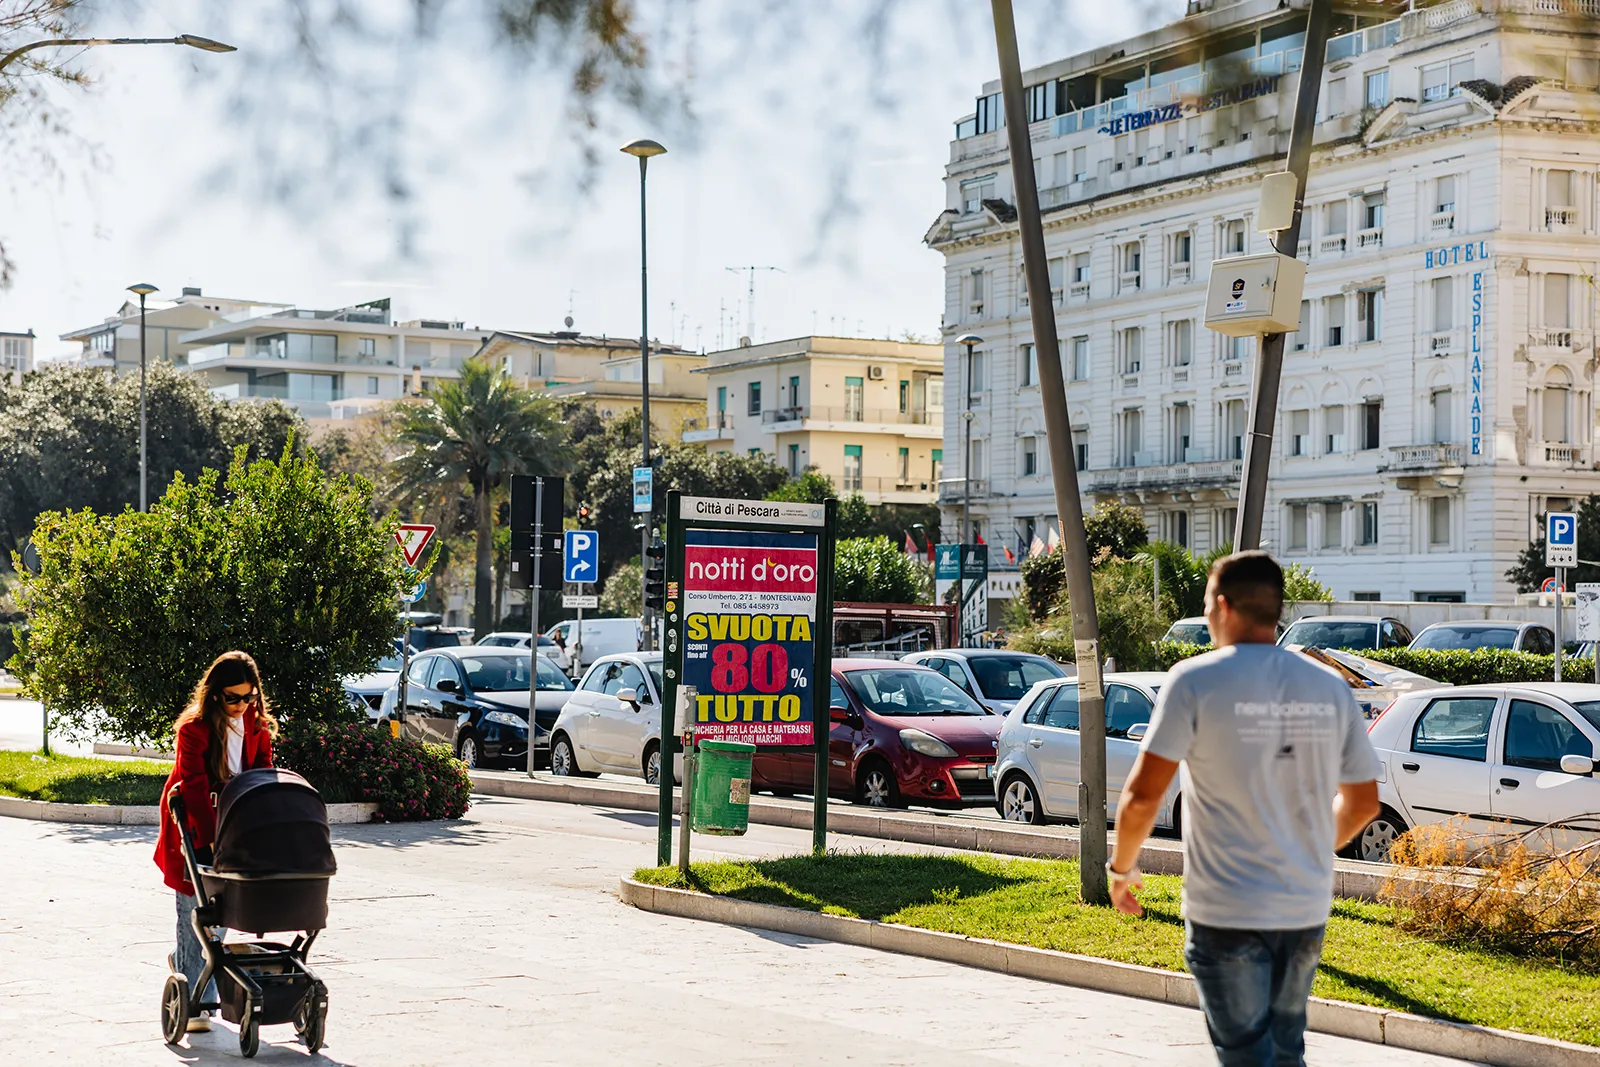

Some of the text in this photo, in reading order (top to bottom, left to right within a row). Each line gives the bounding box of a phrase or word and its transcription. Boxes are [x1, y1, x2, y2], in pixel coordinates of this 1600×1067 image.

[1109, 118, 1122, 137] LE
[1122, 102, 1184, 134] TERRAZZE
[1425, 241, 1488, 270] HOTEL
[1471, 272, 1483, 456] ESPLANADE
[696, 501, 780, 518] Città di Pescara
[1554, 519, 1569, 541] P
[572, 534, 591, 559] P
[689, 556, 745, 580] notti
[688, 592, 708, 601] Corso
[760, 594, 811, 602] MONTESILVANO
[733, 602, 747, 610] 085
[687, 613, 812, 641] SVUOTA
[687, 643, 708, 651] SCONTI
[711, 642, 807, 693] 80 %
[695, 694, 801, 722] TUTTO
[694, 724, 811, 735] NCHERIA PER LA CASA E MATERASSI
[725, 734, 754, 743] MIGLIORI
[756, 734, 782, 743] MARCHI
